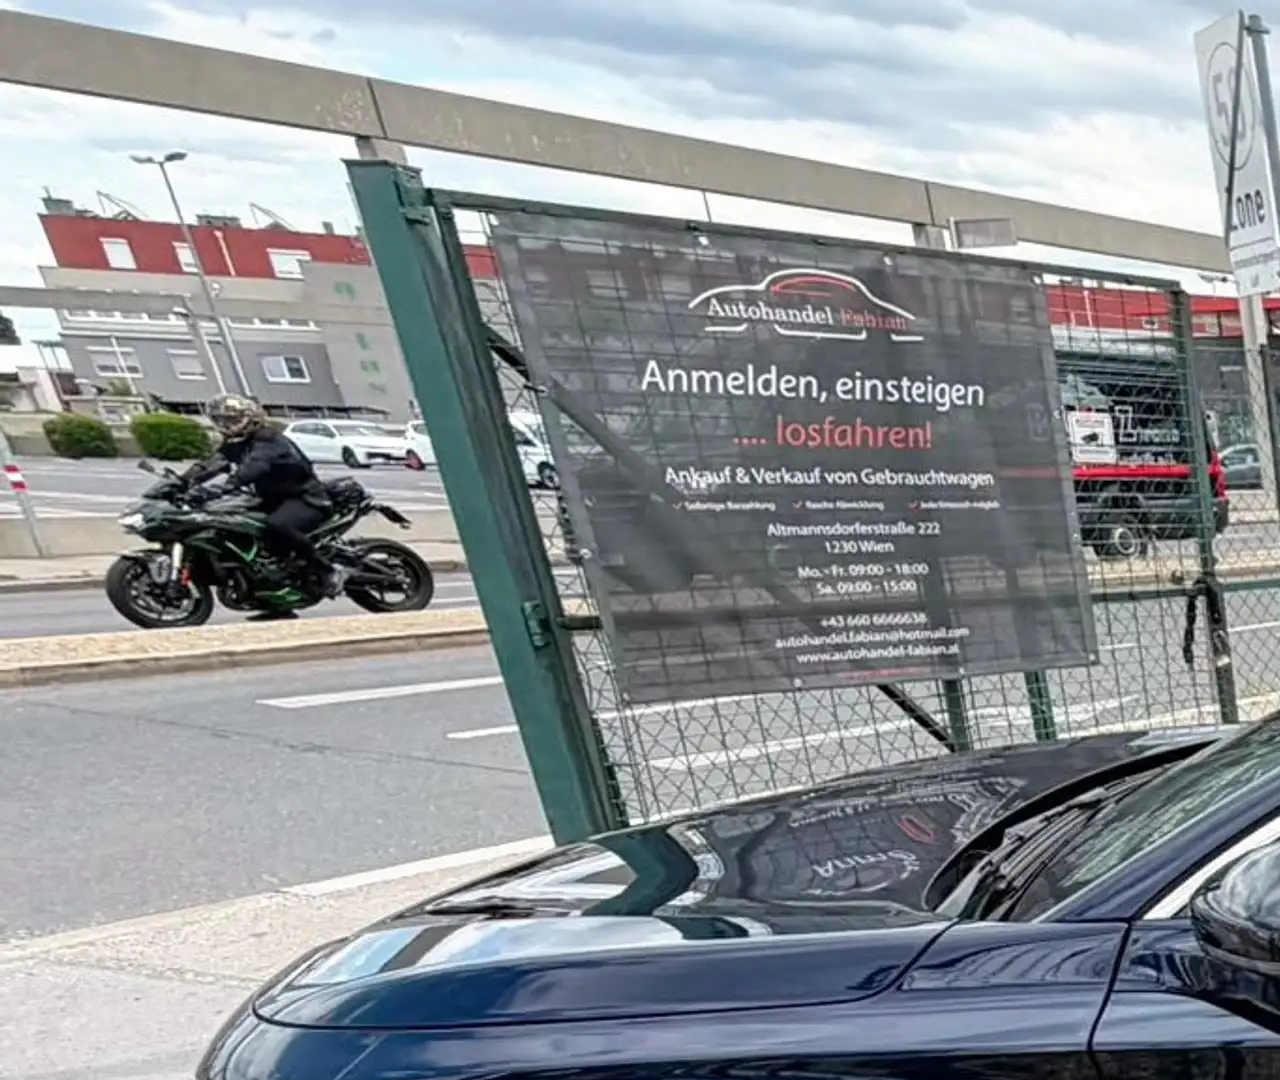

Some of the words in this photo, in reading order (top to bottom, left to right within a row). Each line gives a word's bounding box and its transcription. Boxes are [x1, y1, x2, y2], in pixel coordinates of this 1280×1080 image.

[708, 298, 834, 326] Autohandel
[641, 360, 828, 403] Anmelden,
[836, 371, 984, 412] einsteigen
[777, 416, 933, 449] losfahren!
[665, 467, 731, 487] Ankauf
[736, 467, 750, 485] &
[753, 467, 821, 485] Verkauf
[825, 472, 858, 486] von
[861, 470, 994, 489] Gebrauchtwagen
[918, 522, 940, 535] 222
[825, 541, 858, 553] 1230
[859, 541, 894, 553] Wien
